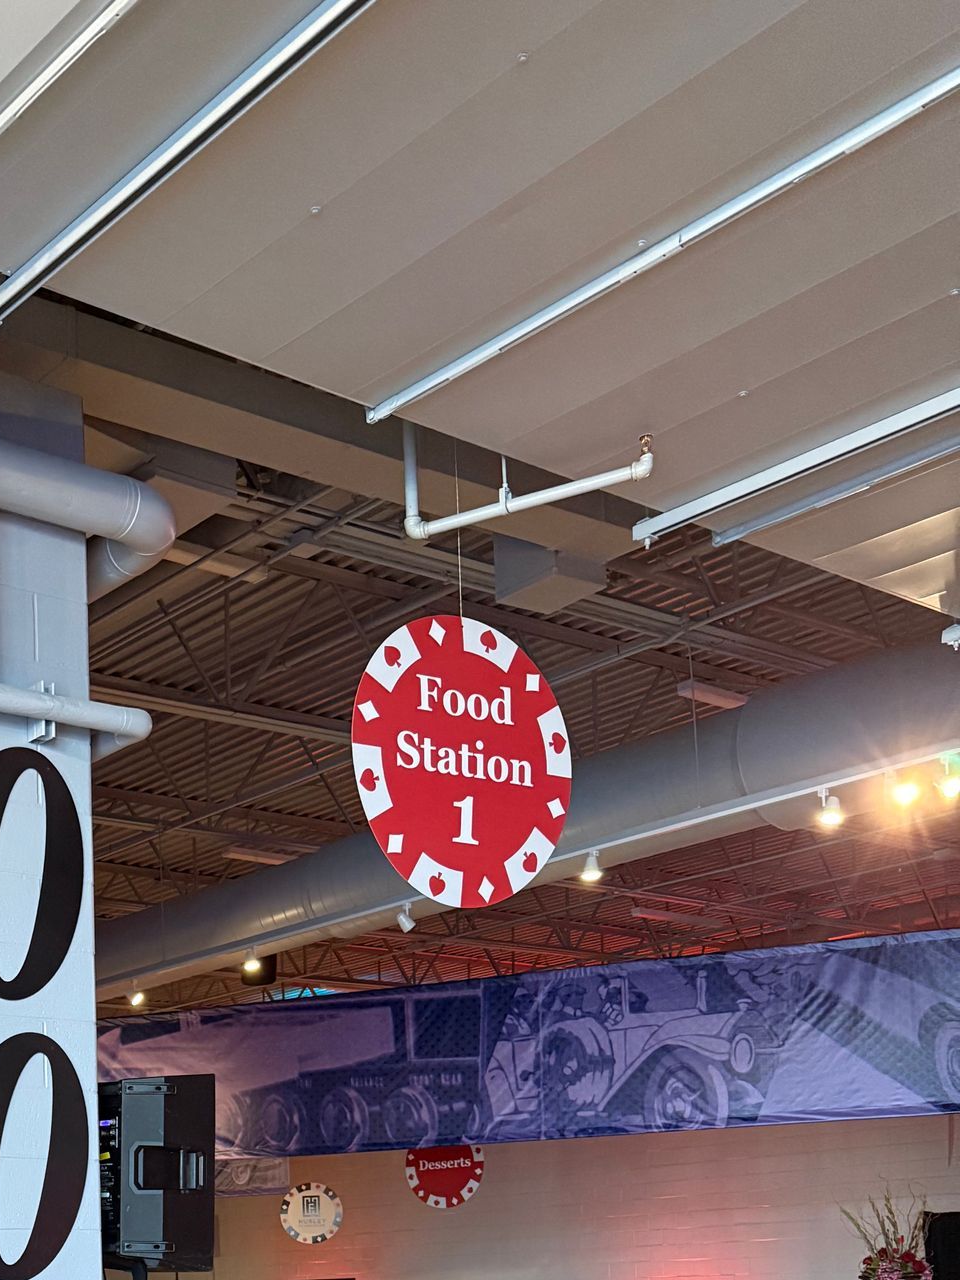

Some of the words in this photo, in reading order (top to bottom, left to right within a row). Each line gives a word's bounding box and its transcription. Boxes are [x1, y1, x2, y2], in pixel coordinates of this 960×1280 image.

[416, 673, 515, 726] Food
[396, 729, 534, 787] Station
[452, 795, 479, 846] 1
[419, 1157, 472, 1172] Desserts
